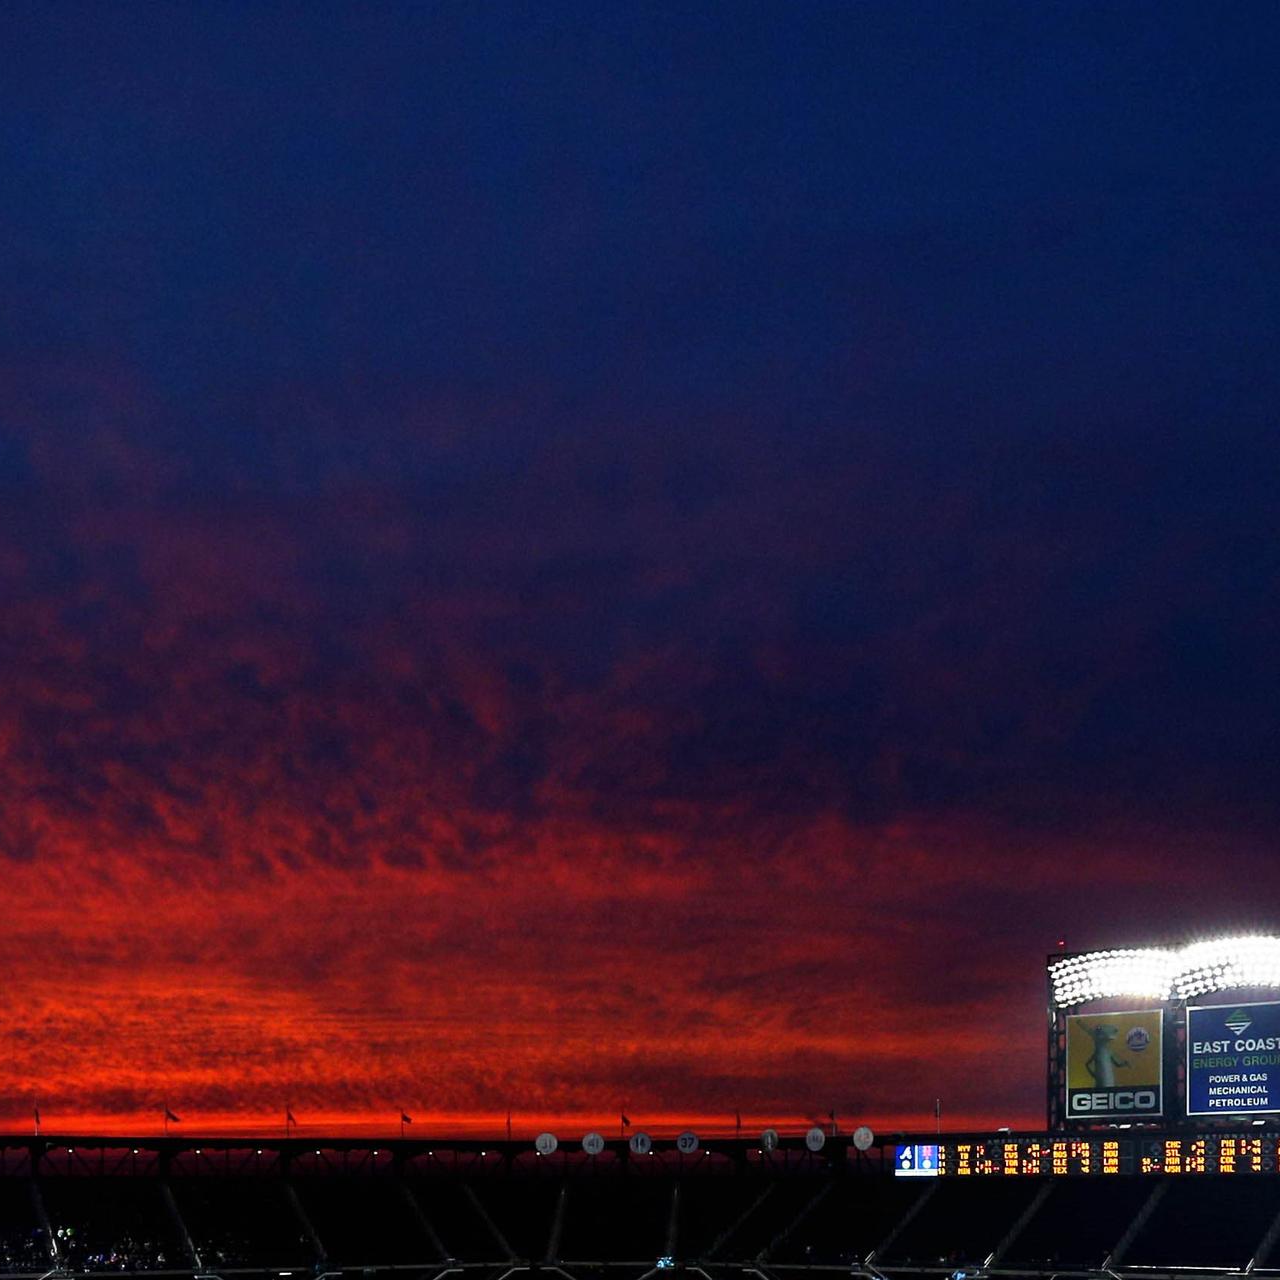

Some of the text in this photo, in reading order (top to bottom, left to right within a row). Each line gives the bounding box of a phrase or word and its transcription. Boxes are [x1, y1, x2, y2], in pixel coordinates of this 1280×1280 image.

[1193, 1040, 1230, 1054] EAST
[1193, 1056, 1238, 1069] ENERGY
[1209, 1072, 1268, 1084] POWER & GAS
[1209, 1085, 1269, 1096] MECHANICAL
[1072, 1090, 1156, 1111] GEICO
[1209, 1098, 1269, 1108] PETROLEUM
[1221, 1147, 1235, 1155] CIN
[1220, 1156, 1236, 1164] COL
